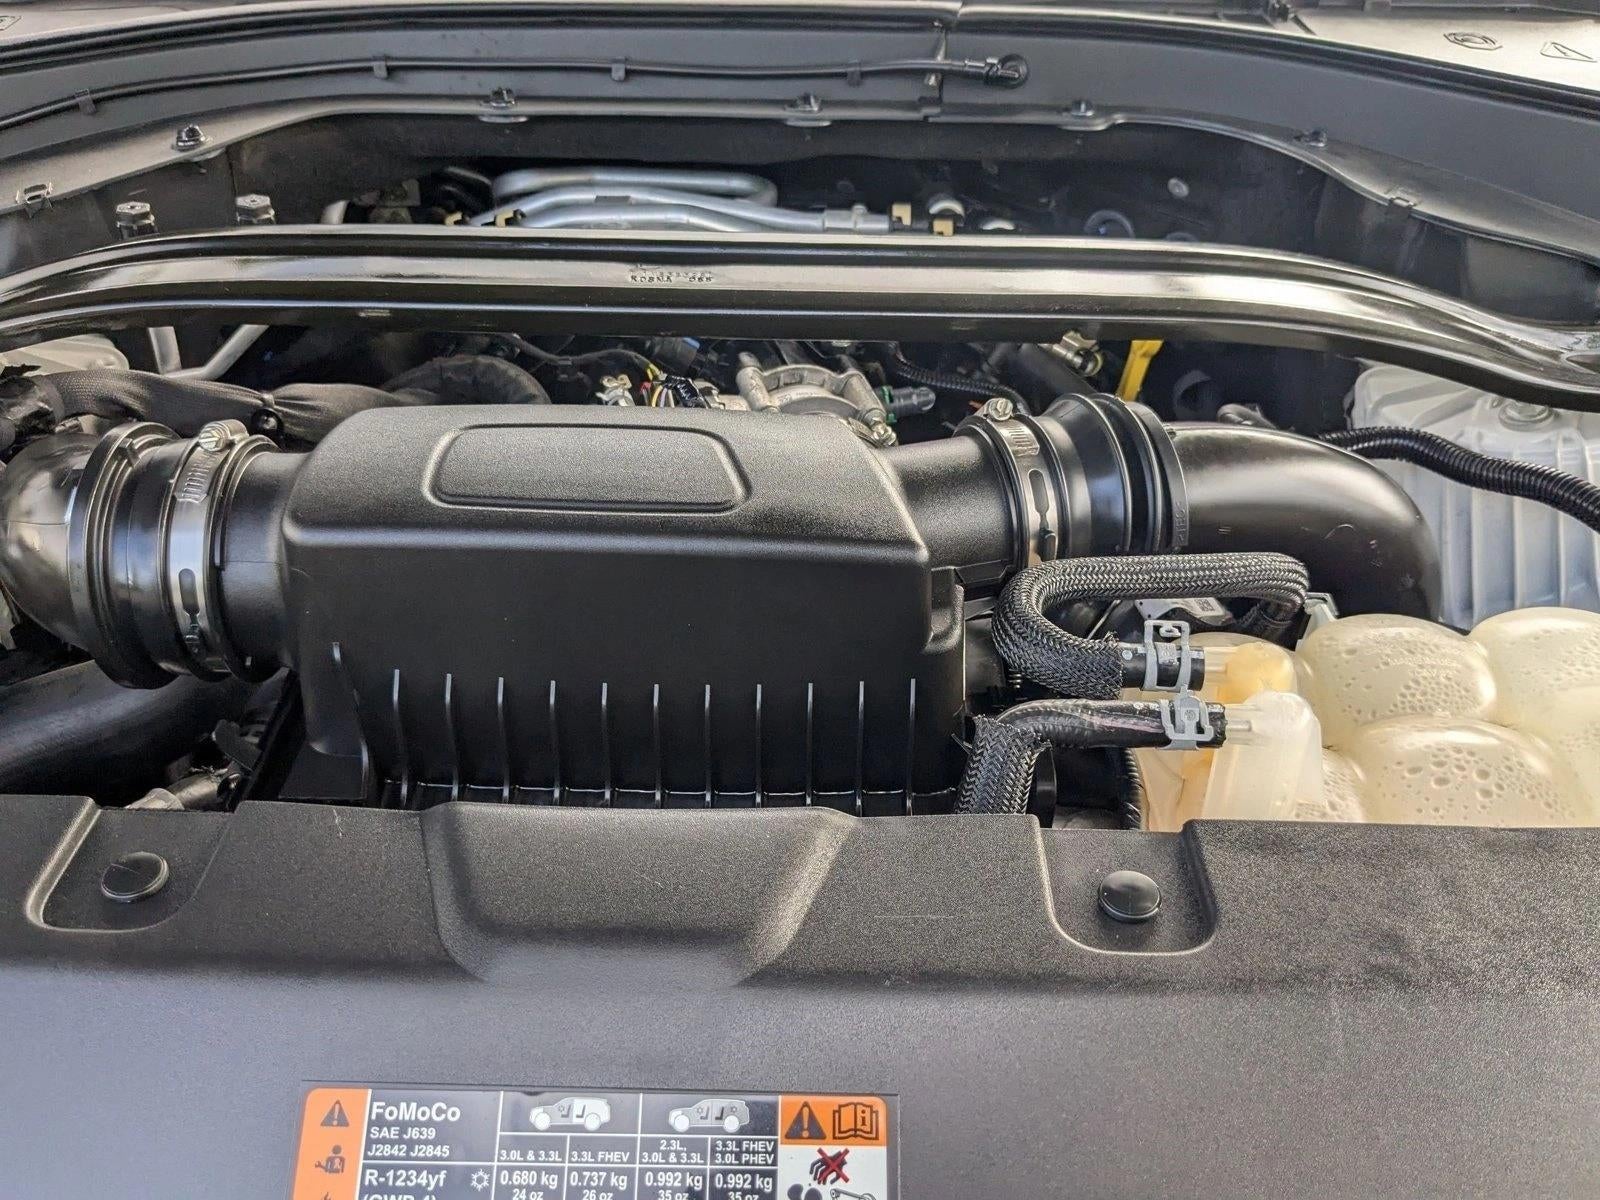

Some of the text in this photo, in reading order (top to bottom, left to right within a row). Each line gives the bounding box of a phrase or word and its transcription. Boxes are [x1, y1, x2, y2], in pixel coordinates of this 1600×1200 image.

[371, 1101, 461, 1122] FoMoCo
[370, 1126, 436, 1140] SAE J639
[367, 1144, 450, 1158] J2842 J2845
[660, 1140, 687, 1151] 2.3L,
[716, 1141, 775, 1152] 3.3L FHEV
[500, 1150, 562, 1161] 3.0L & 3.3L
[571, 1151, 630, 1162] 3.3L FHEV
[642, 1152, 704, 1163] 3.0L & 3.3L
[715, 1153, 774, 1164] 3.0L PHEV
[364, 1169, 447, 1191] R-1234yf
[500, 1170, 558, 1189] 0.680 kg
[570, 1171, 628, 1190] 0.737 kg
[645, 1171, 703, 1190] 0.992 kg
[715, 1173, 773, 1192] 0.992 kg
[512, 1188, 544, 1200] 24 oz
[582, 1189, 613, 1200] 26 oz
[658, 1190, 689, 1200] 35 oz
[728, 1191, 742, 1200] 35
